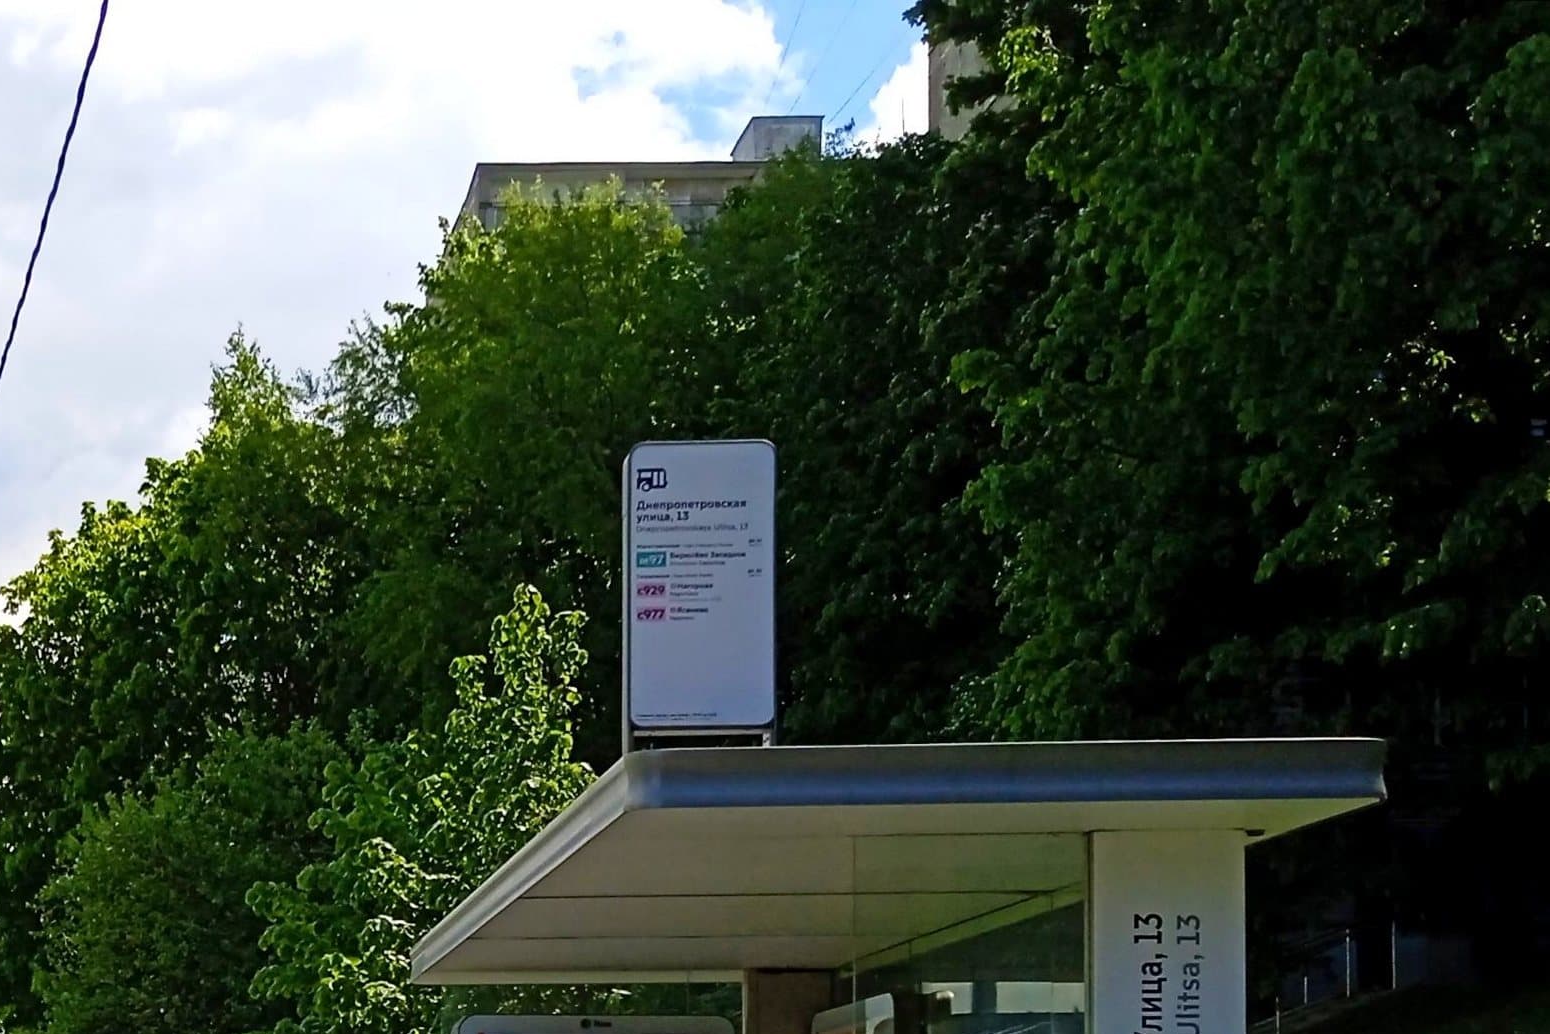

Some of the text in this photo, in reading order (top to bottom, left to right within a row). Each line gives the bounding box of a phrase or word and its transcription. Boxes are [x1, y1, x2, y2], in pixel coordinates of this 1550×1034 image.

[636, 500, 747, 512] Днепропетровская
[636, 511, 690, 524] улица, 13
[1133, 913, 1163, 944] 13
[1176, 914, 1200, 945] 13
